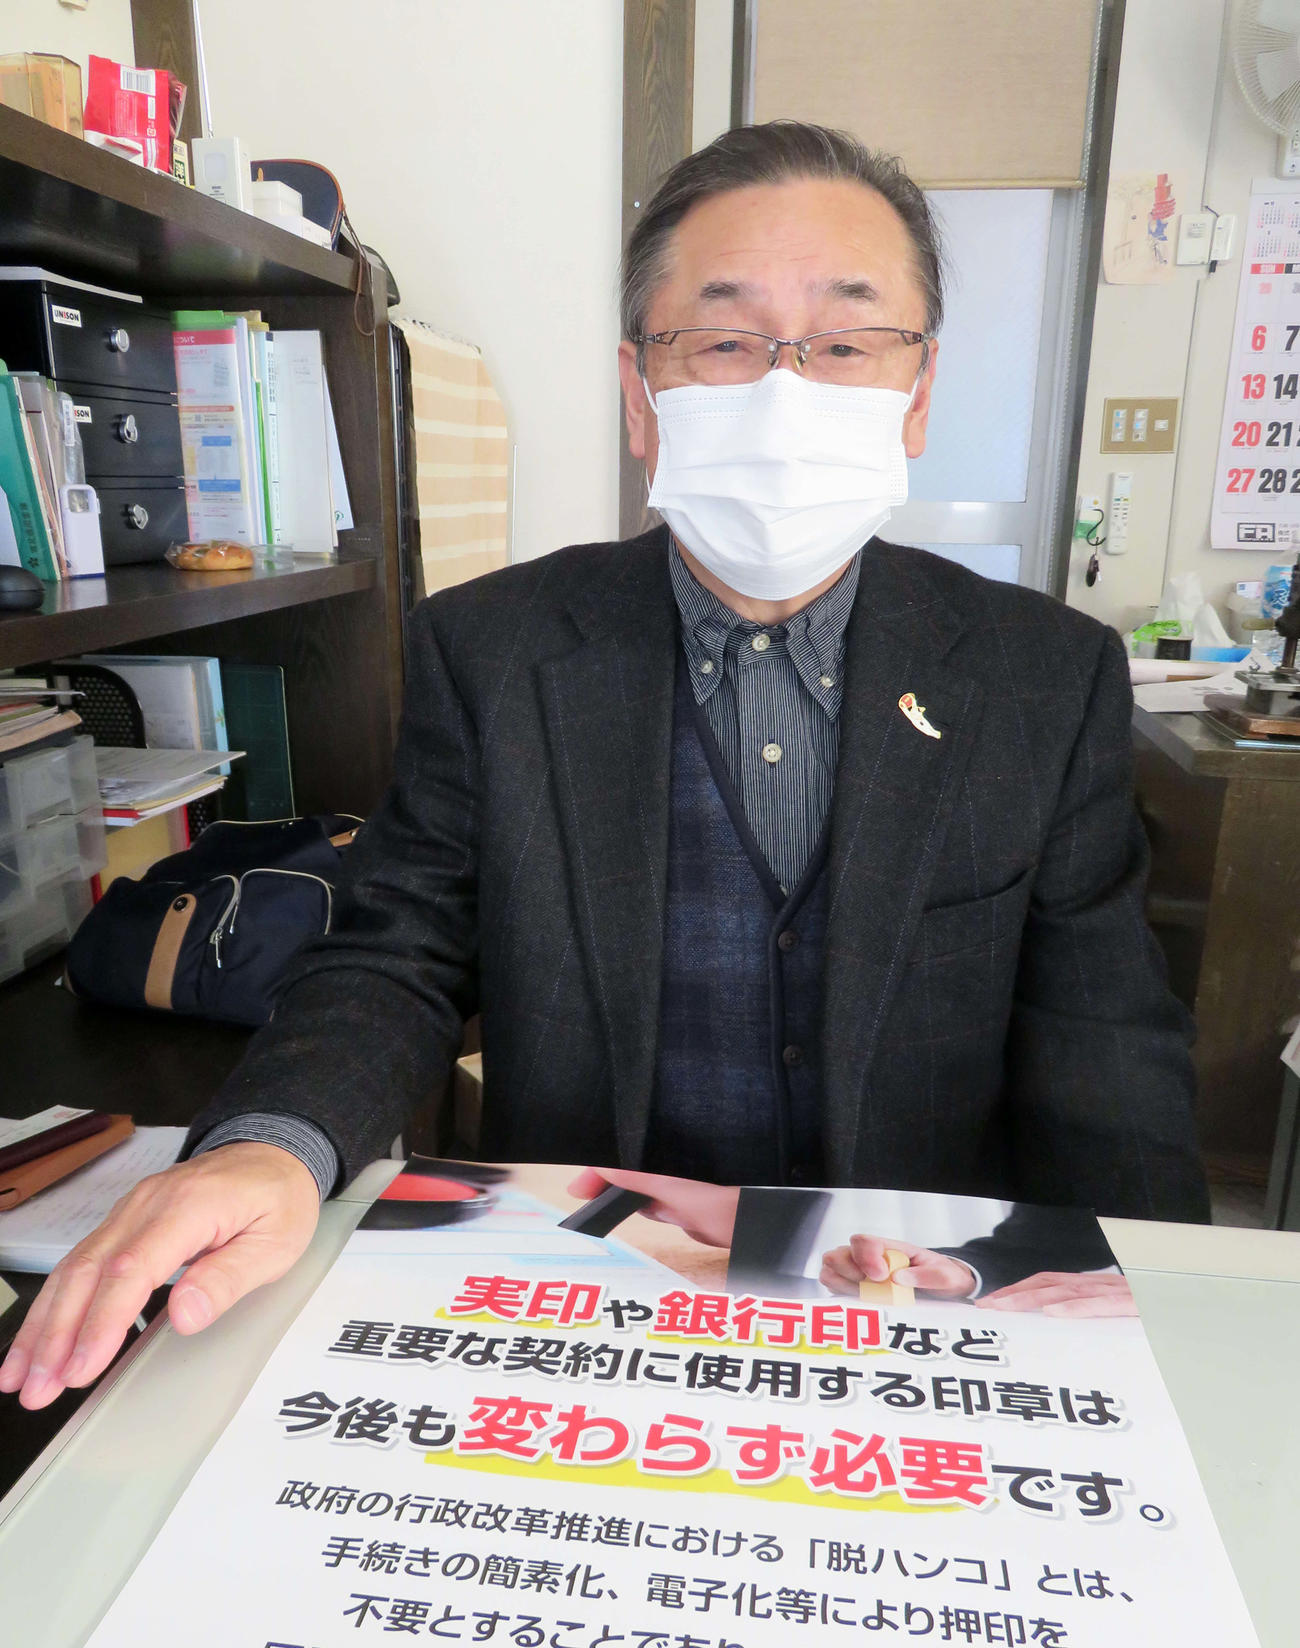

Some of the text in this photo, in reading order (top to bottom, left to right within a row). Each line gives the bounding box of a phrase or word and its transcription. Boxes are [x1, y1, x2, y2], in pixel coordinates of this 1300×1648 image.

[54, 309, 80, 322] UNISON
[1252, 325, 1300, 351] 6 7
[1241, 373, 1299, 399] 13 14
[1231, 421, 1261, 447] 20
[1265, 421, 1293, 447] 21
[1226, 468, 1300, 493] 27 28 2
[450, 1275, 1000, 1362] 実印や銀行印など
[329, 1319, 1122, 1427] 重要な契約に使用する印章は
[278, 1390, 1165, 1523] 今後も変わらず必要です。
